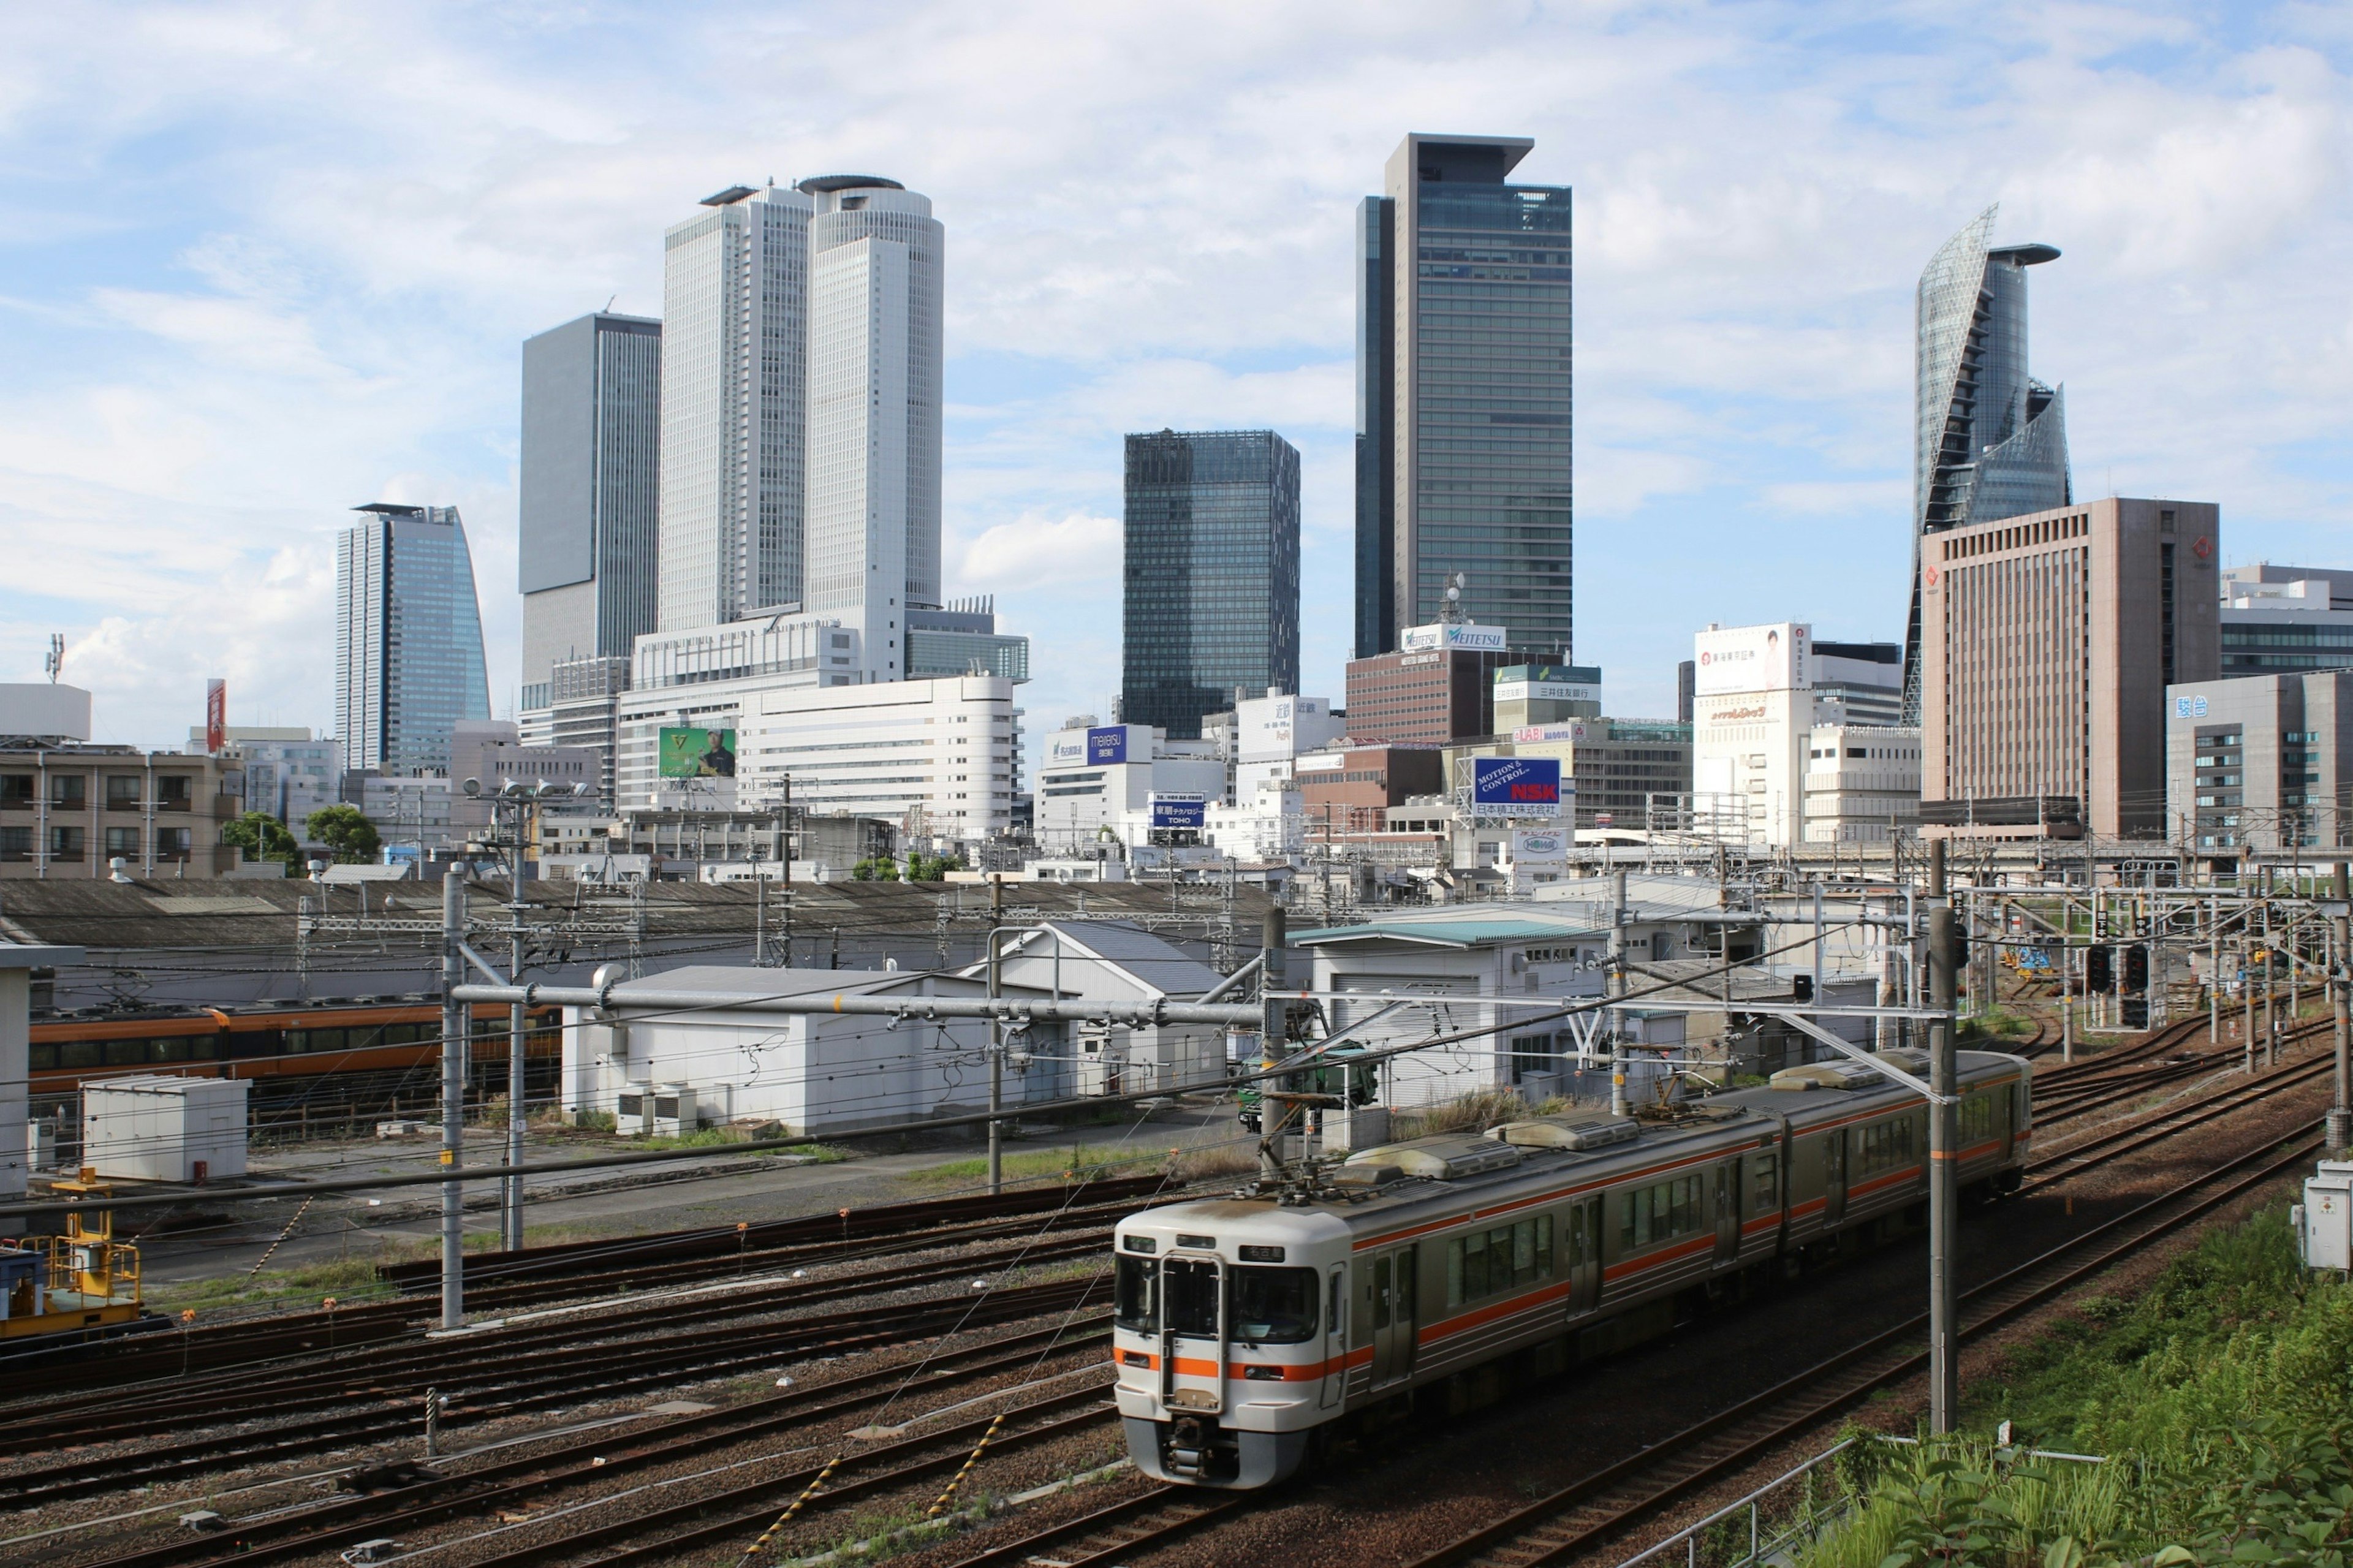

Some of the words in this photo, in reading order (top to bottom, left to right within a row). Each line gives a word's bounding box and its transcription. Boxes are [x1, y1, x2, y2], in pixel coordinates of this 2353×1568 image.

[1405, 629, 1436, 647] MEITETSU
[1446, 626, 1501, 645] MEITETSU
[1496, 688, 1525, 698] 三井住友銀行
[1540, 687, 1588, 698] 三井住友銀行
[1297, 703, 1316, 713] 近鉄
[2176, 696, 2207, 718] 駿台
[1520, 728, 1543, 742] LABI
[1544, 731, 1569, 740] NAGOYA
[1477, 762, 1515, 785] MOTION
[1510, 784, 1558, 800] NSK
[1156, 805, 1204, 815] 東朋テクノロジー
[1477, 805, 1556, 814] 日本精工株式会社
[1526, 841, 1555, 849] HOWA
